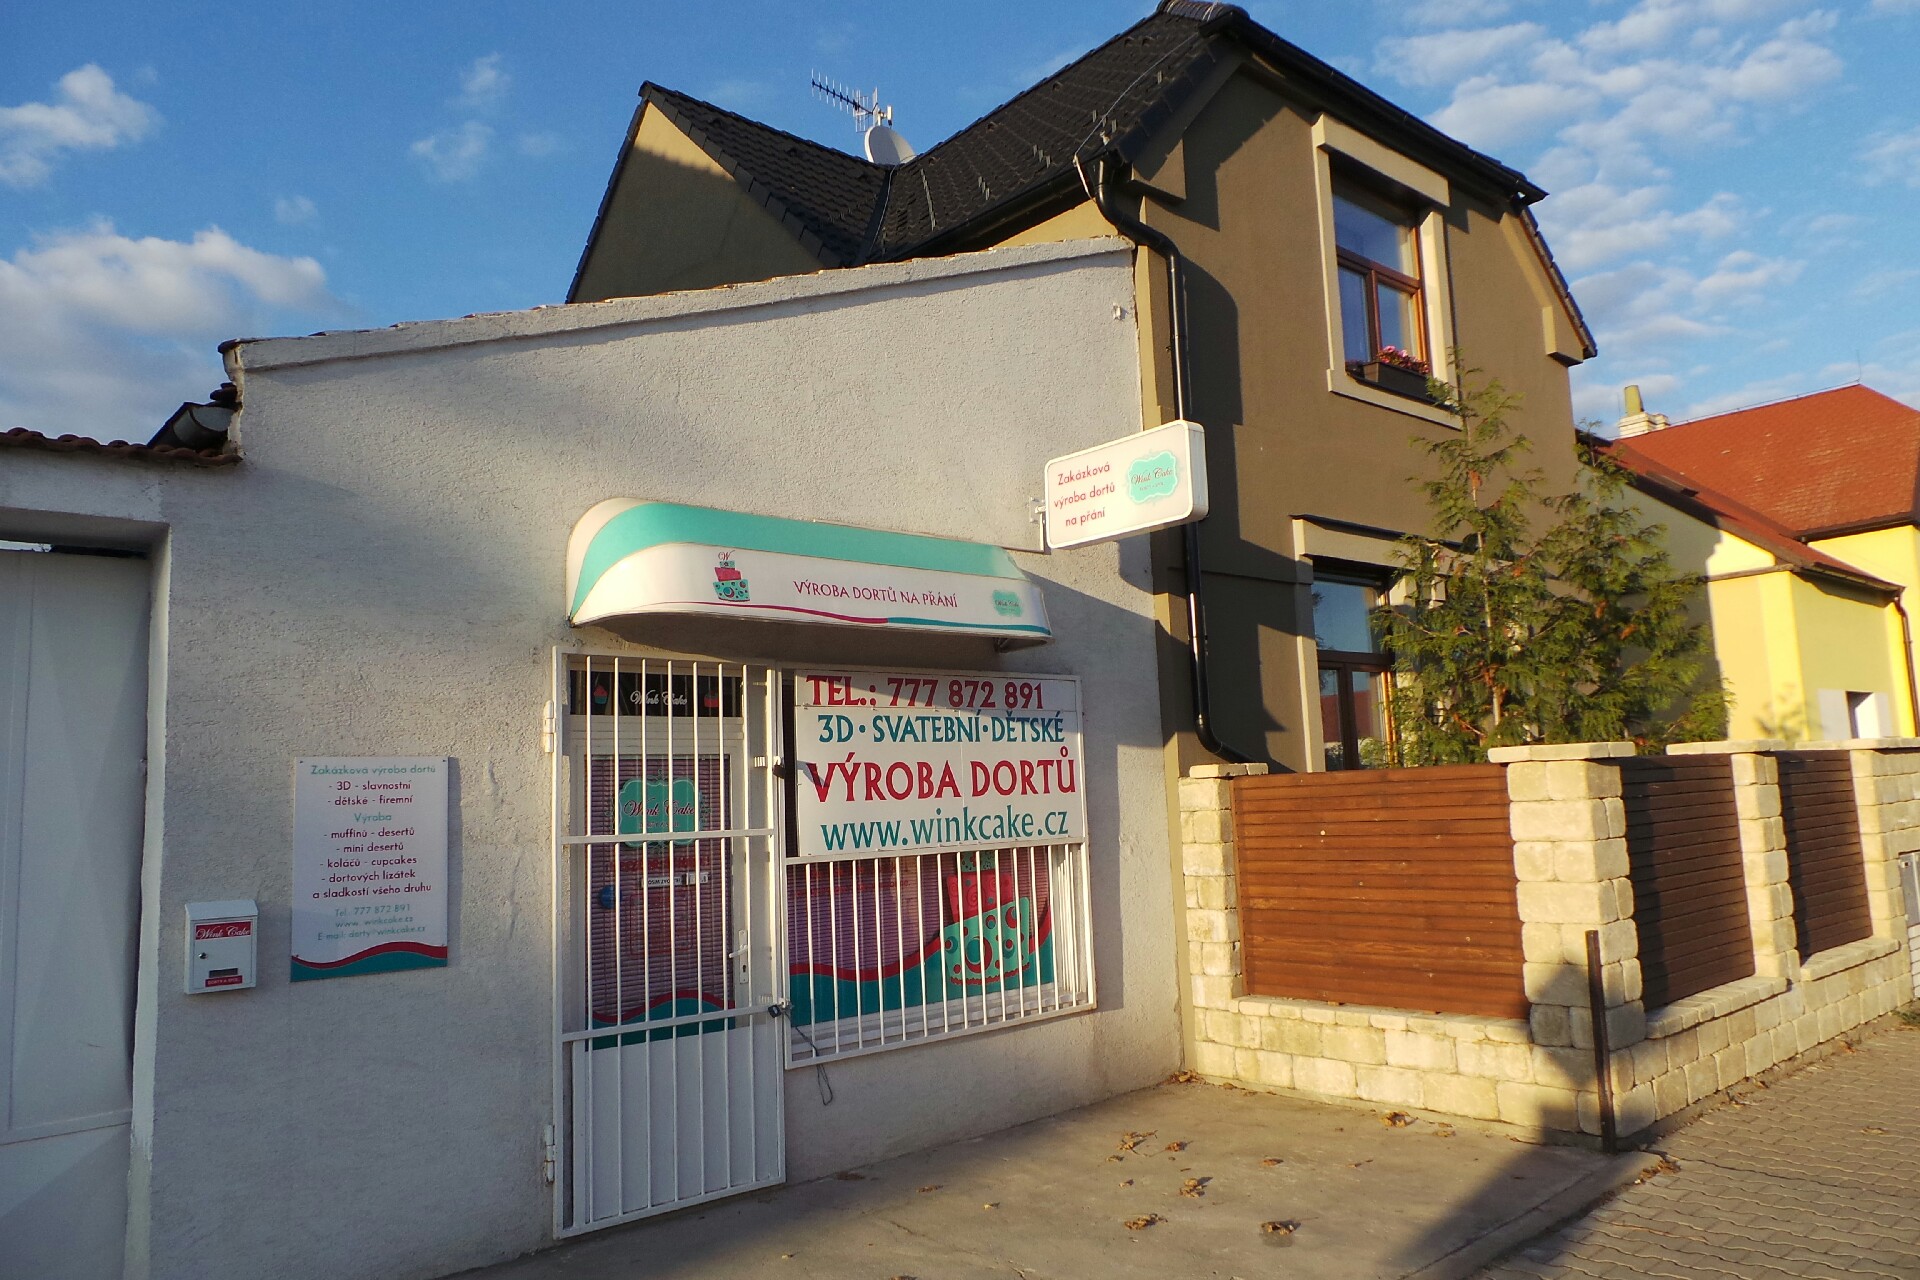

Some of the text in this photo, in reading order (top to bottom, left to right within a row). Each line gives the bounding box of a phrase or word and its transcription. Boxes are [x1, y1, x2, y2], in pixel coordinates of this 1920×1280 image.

[1058, 461, 1110, 486] Zakázková
[1053, 482, 1115, 508] výroba dortů
[1065, 506, 1106, 527] na přání
[793, 579, 958, 608] VÝROBA DORTŮ NA PŘÁNÍ
[806, 675, 1044, 709] TEL.: 777 872 891
[817, 714, 854, 743] 3D
[310, 764, 436, 776] Zakázková výroba dortů
[806, 746, 1076, 803] VÝROBA DORTŮ
[336, 780, 412, 791] 3D slavnostní
[334, 794, 414, 806] dětské firemní
[624, 797, 658, 816] Wnk
[354, 812, 392, 824] Výroba
[331, 827, 415, 839] muffinů desertů
[820, 804, 1070, 851] www.winkcake.cz
[343, 842, 404, 853] mini desertů
[327, 855, 417, 868] koláčů cupcakes
[329, 871, 379, 883] dortových
[323, 886, 370, 898] sladkostí
[372, 885, 400, 895] všeho
[404, 882, 431, 893] druhu
[354, 906, 372, 915] 777
[374, 905, 391, 913] 872
[394, 903, 410, 912] 891
[196, 925, 250, 939] Wink Cake
